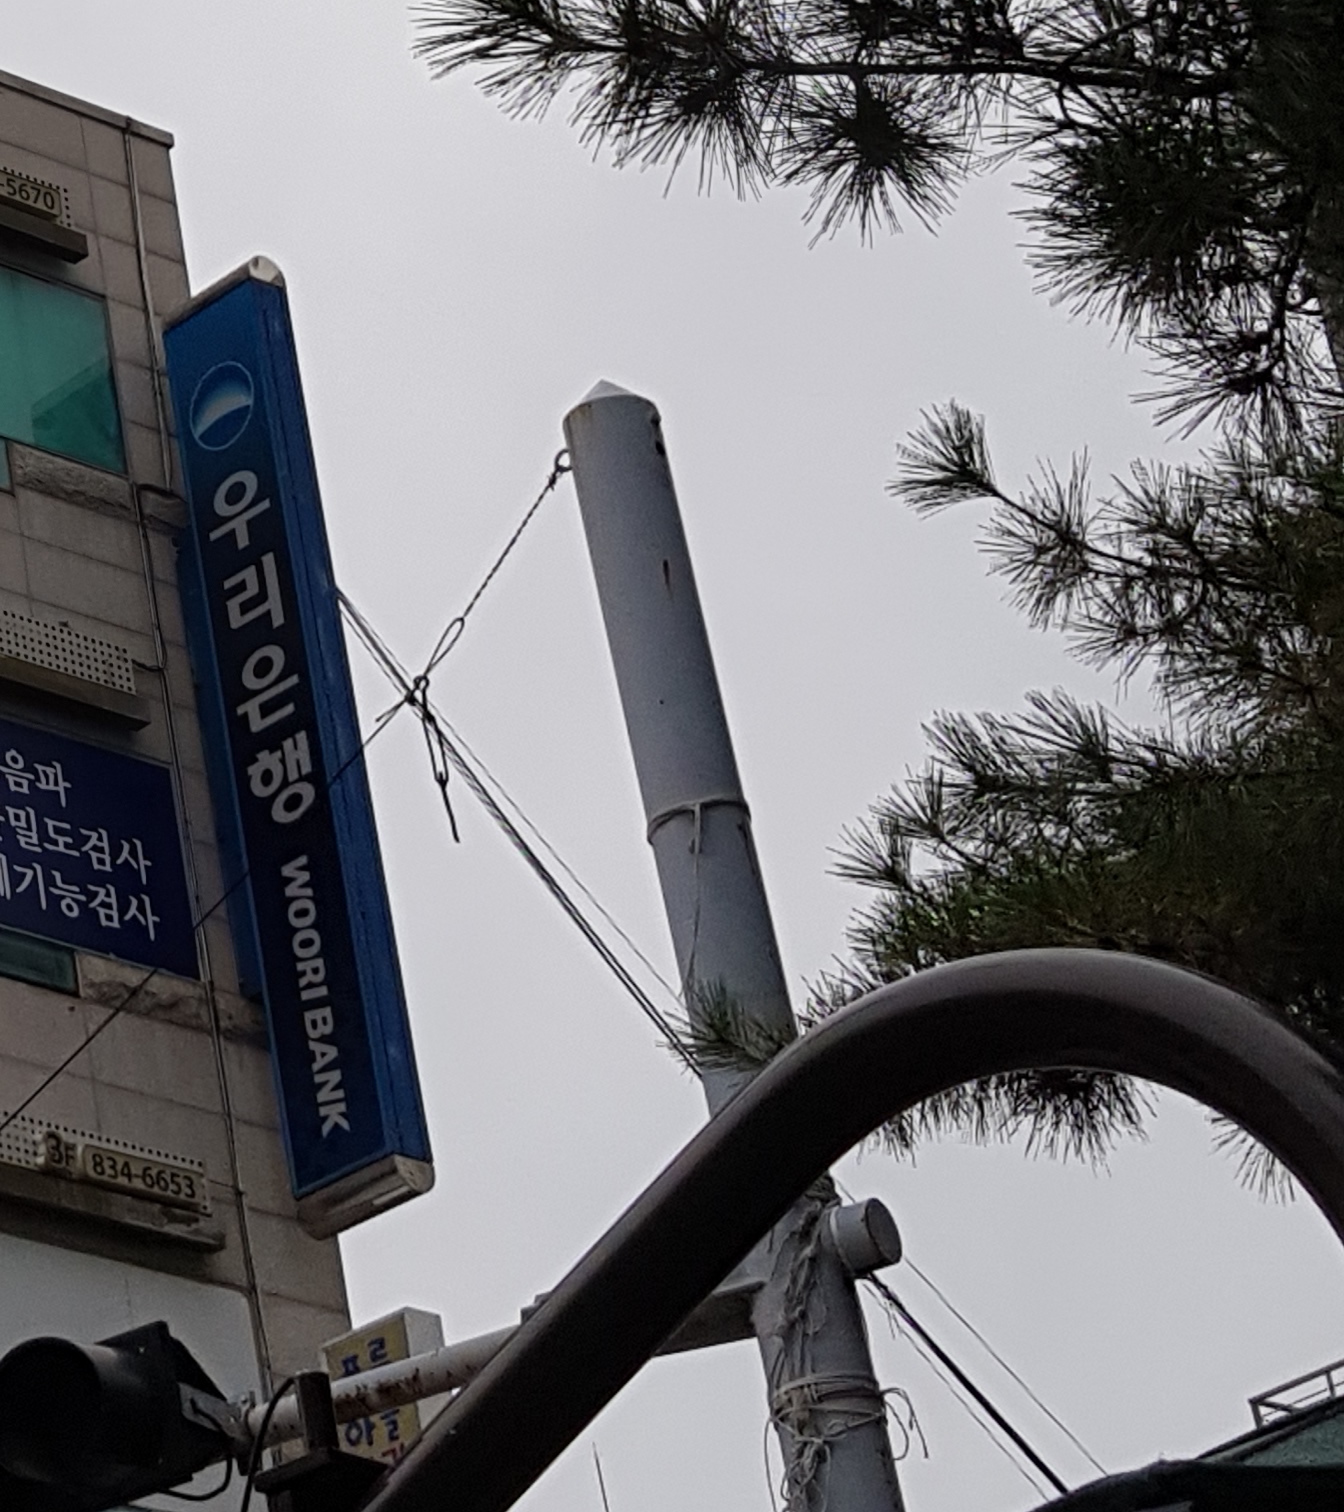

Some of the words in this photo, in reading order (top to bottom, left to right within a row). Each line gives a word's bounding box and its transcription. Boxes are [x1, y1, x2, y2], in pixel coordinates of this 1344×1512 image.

[209, 469, 316, 825] 우리은행
[279, 854, 330, 1000] WOORI
[303, 1003, 352, 1138] BANK
[91, 1153, 196, 1199] 834-6653
